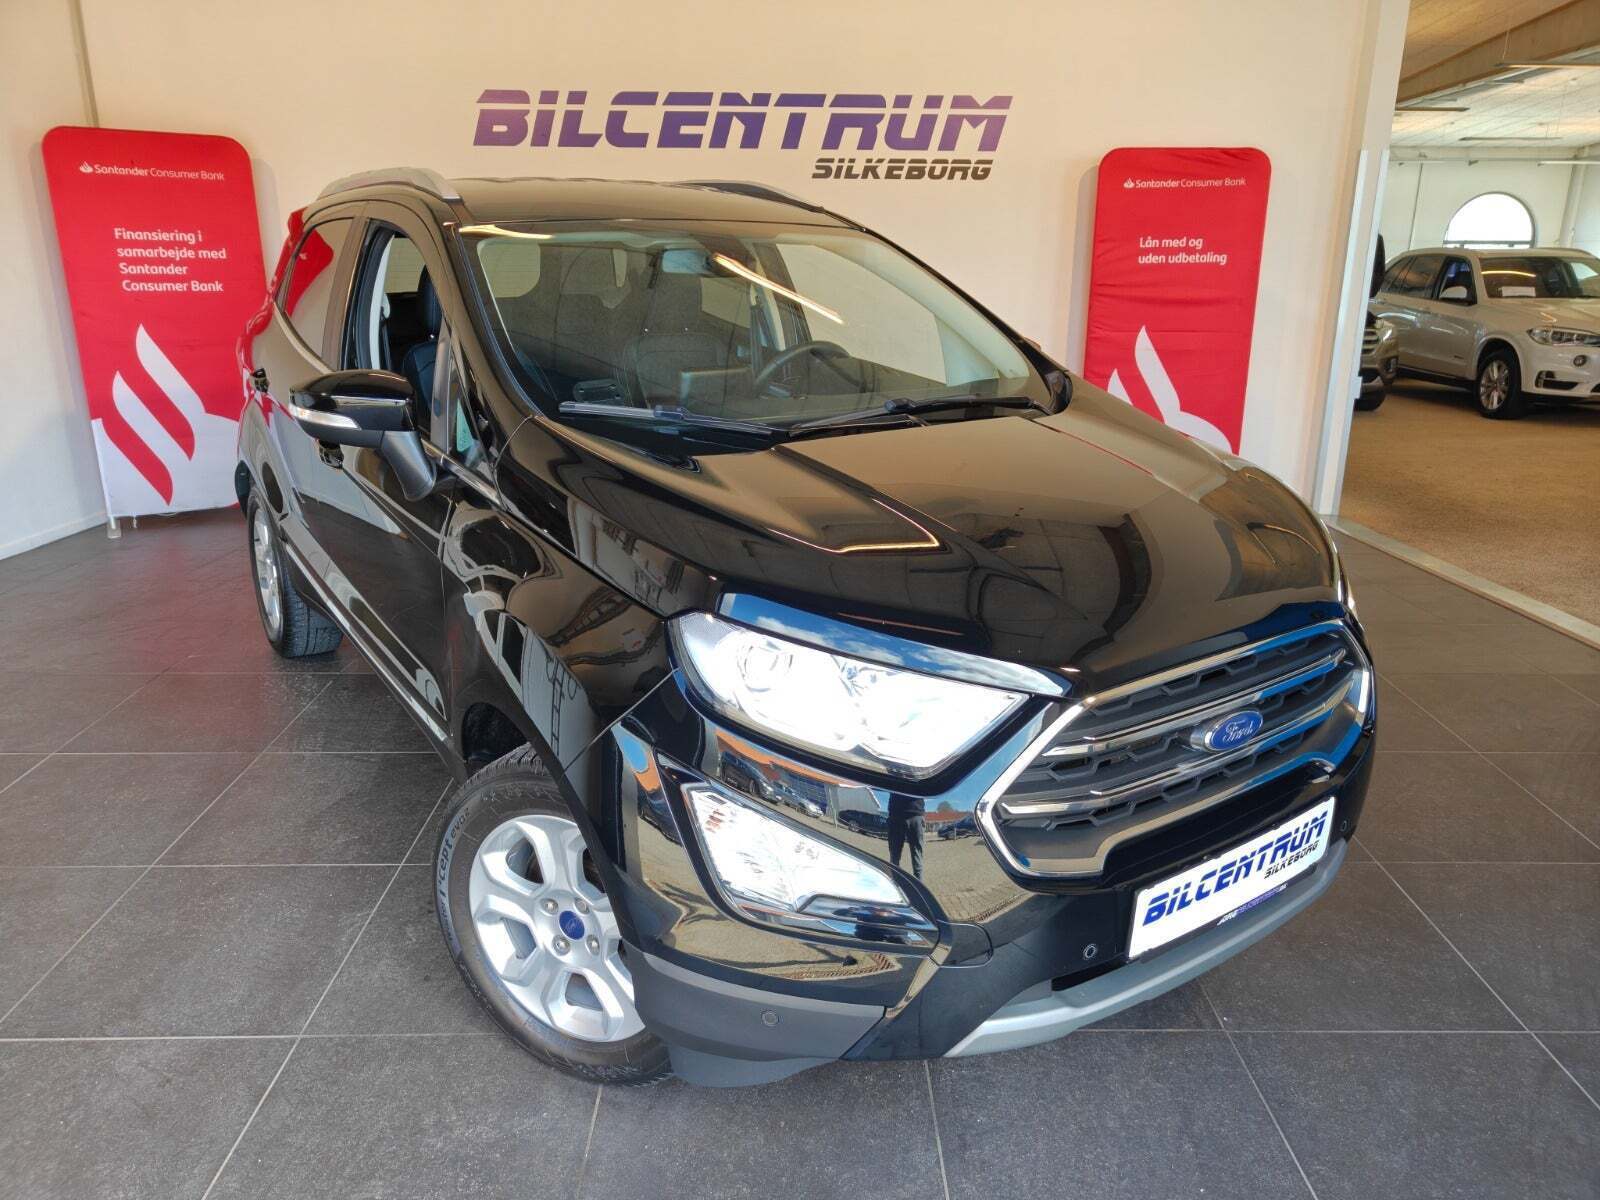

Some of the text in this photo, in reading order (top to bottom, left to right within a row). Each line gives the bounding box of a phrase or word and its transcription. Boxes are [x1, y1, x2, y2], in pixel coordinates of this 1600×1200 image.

[473, 89, 1013, 152] BILCENTRUM
[94, 164, 225, 181] Santander Consumer Bank
[812, 158, 993, 181] SILKEBORG
[1135, 177, 1246, 188] Santander Consumer Bank
[114, 228, 203, 244] Finansiering i
[1139, 236, 1203, 249] Lån med og
[117, 246, 226, 261] samarbejde med
[1138, 251, 1228, 265] uden udbetaling
[119, 262, 188, 275] Santander
[122, 279, 224, 292] Consumer Bank
[1222, 719, 1255, 742] Ford
[1264, 839, 1320, 879] SILKEBORG
[1144, 810, 1328, 926] BILCENTRUM
